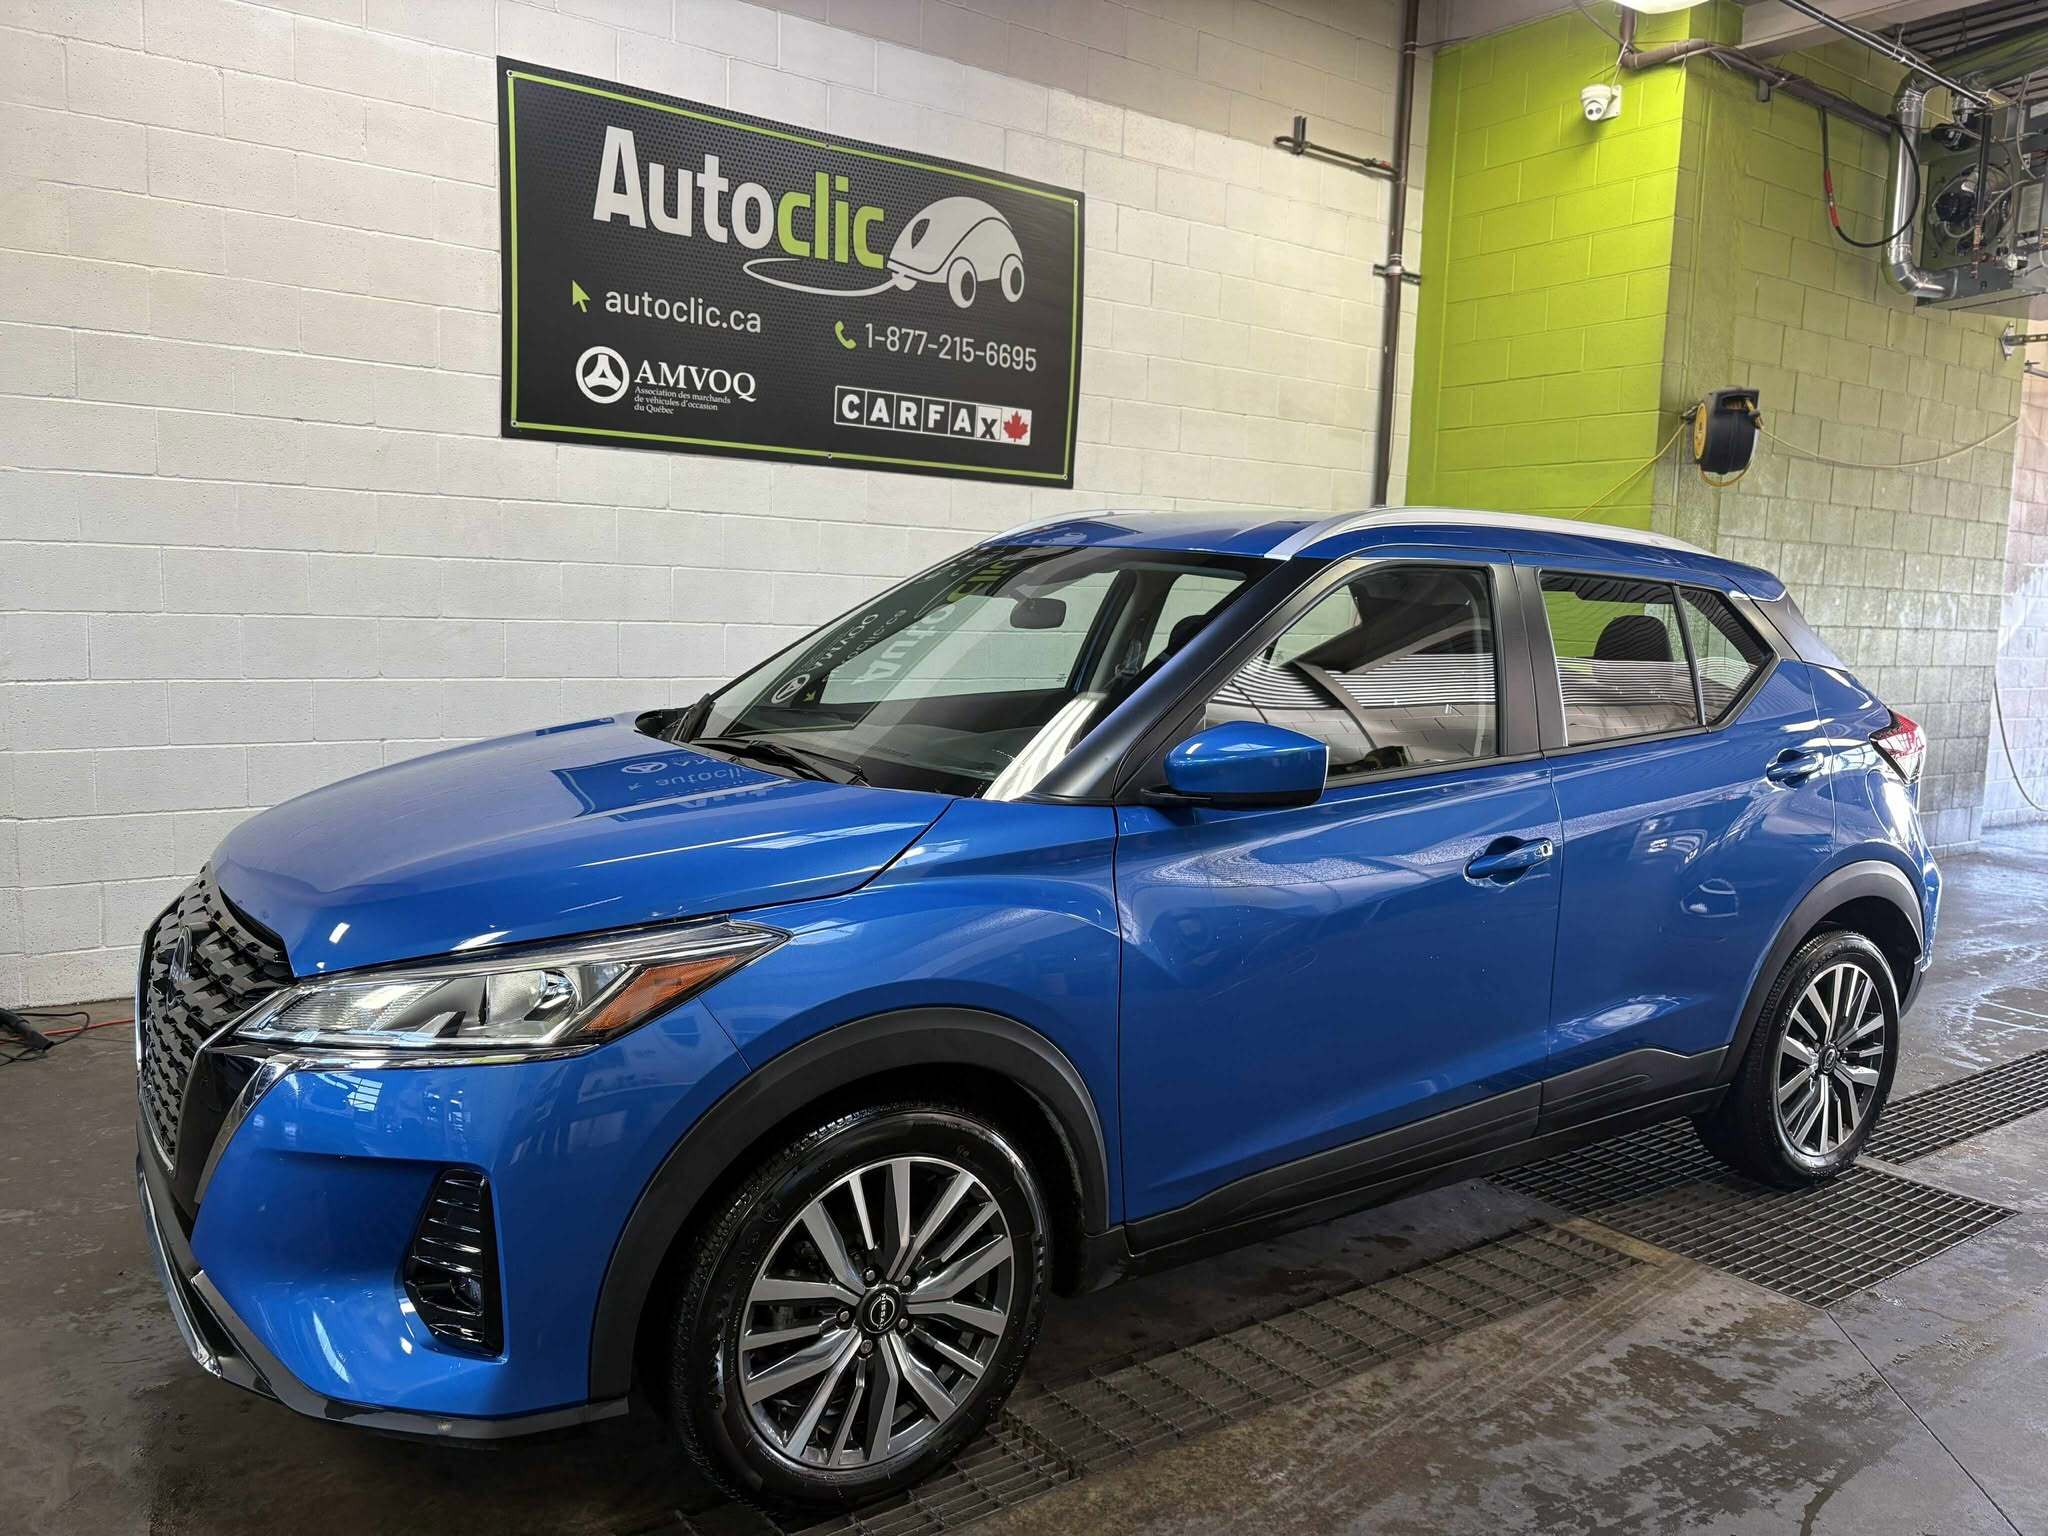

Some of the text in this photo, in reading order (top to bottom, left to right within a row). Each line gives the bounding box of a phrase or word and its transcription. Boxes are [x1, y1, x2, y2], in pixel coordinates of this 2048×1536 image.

[593, 125, 885, 270] Autoclic
[604, 290, 761, 334] autoclic.ca
[865, 322, 1037, 373] 1-877-215-6695
[634, 359, 757, 403] AMVOQ
[634, 386, 731, 404] Association des marchands
[634, 395, 718, 411] de véhicules d'occasion
[634, 403, 674, 415] du Québec
[841, 393, 999, 440] CARFAX
[878, 1292, 887, 1329] NISSAN
